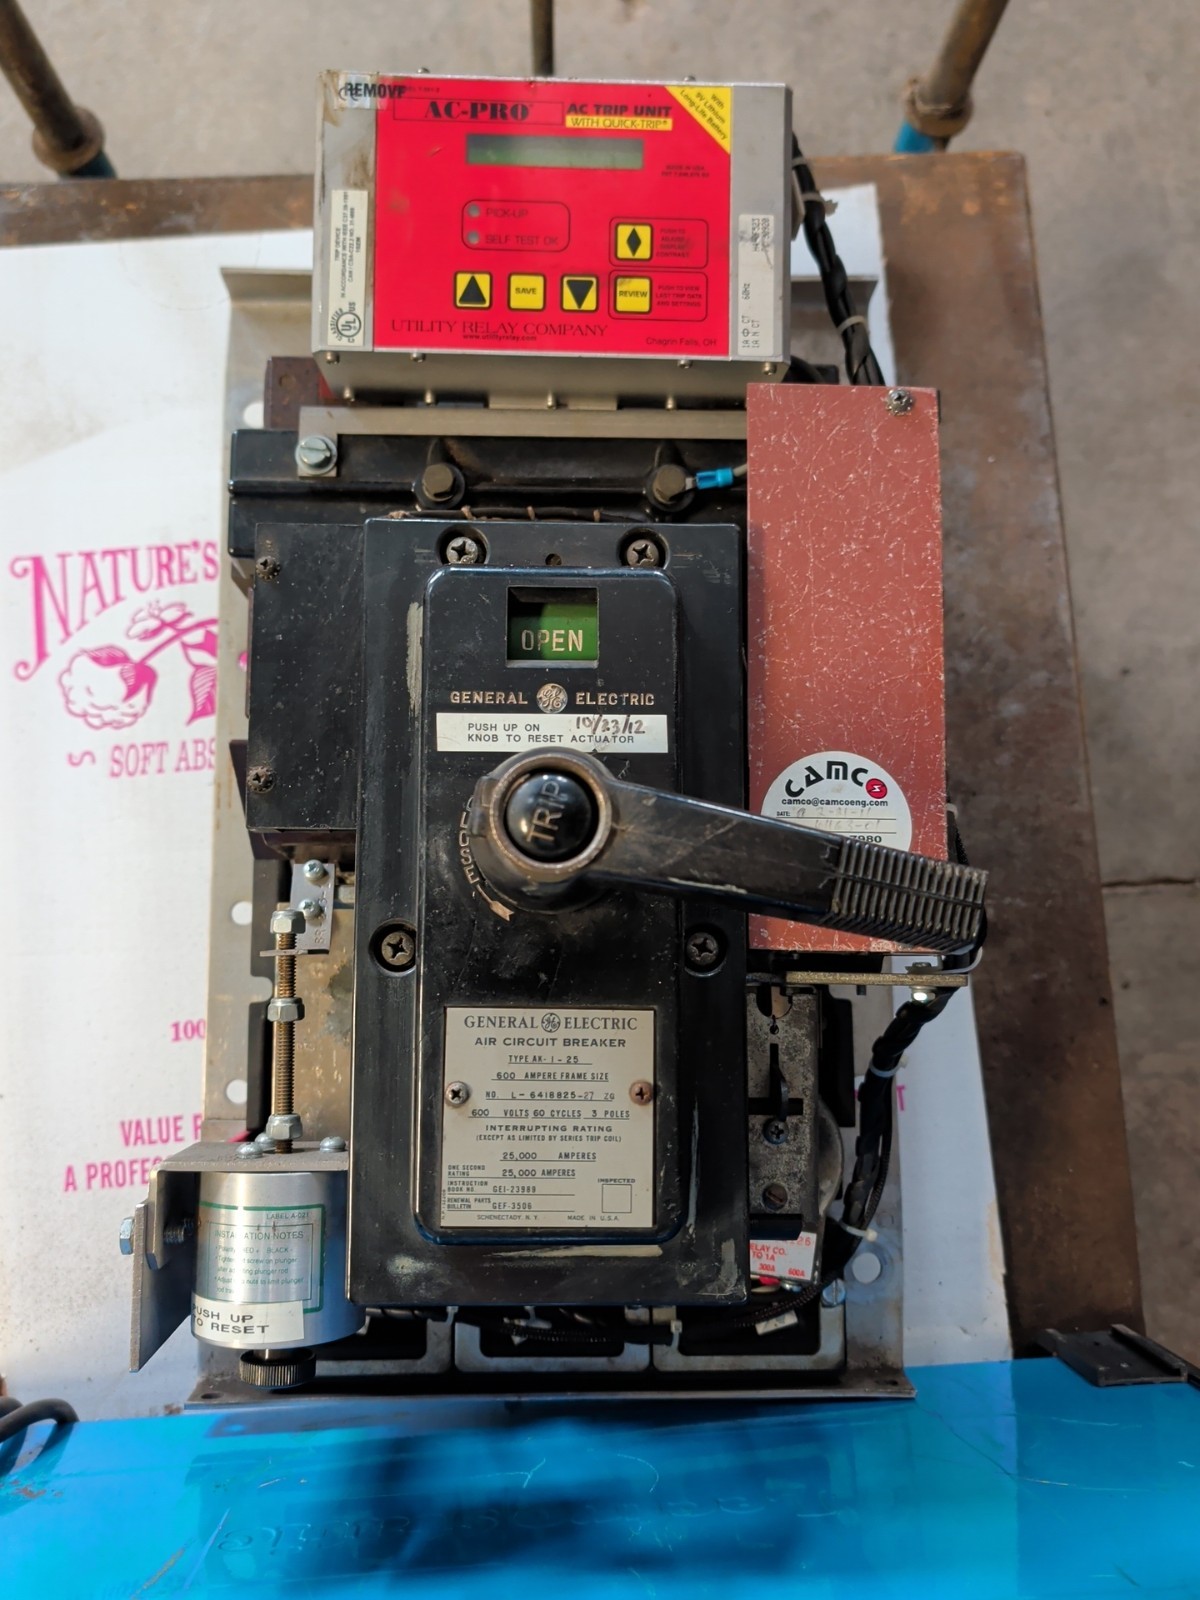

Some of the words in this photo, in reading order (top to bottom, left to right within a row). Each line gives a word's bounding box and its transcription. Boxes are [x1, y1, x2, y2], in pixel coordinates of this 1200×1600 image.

[710, 93, 725, 110] With
[425, 101, 530, 121] AC-PRO
[566, 103, 588, 115] AC
[593, 104, 628, 116] TRIP
[634, 105, 673, 117] UNIT
[680, 90, 707, 119] Long-Life
[706, 117, 728, 141] Battery
[571, 117, 600, 127] WITH
[486, 207, 529, 219] PICK-UP
[485, 233, 511, 245] SELF
[515, 235, 540, 245] TEST
[543, 236, 560, 246] OK
[514, 287, 537, 295] SAVE
[618, 289, 648, 298] REVIEW
[391, 319, 458, 334] UTILITY
[463, 321, 532, 335] RELAY
[536, 322, 608, 337] COMPANY
[462, 332, 538, 342] www.utilityrelay.com
[645, 337, 676, 347] Chagrin
[679, 338, 702, 348] Falls,
[703, 338, 718, 347] OH
[10, 540, 219, 681] NATURE'S
[521, 629, 583, 652] OPEN
[449, 690, 529, 705] GENERAL
[575, 692, 656, 706] ELECTRIC
[468, 723, 498, 732] PUSH
[503, 723, 518, 732] UP
[524, 723, 540, 732] ON
[575, 714, 647, 735] 10/23/12
[467, 734, 499, 743] KNOB
[506, 734, 522, 743] TO
[528, 734, 564, 743] RESET
[570, 735, 635, 744] ACTUATOR
[109, 742, 169, 778] SOFT
[781, 798, 889, 808] camco@camcoeng.com
[526, 780, 566, 843] TRIP
[463, 1015, 539, 1029] GENERAL
[564, 1016, 639, 1031] ELECTRIC
[474, 1037, 497, 1047] AIR
[502, 1037, 558, 1047] CIRCUIT
[563, 1038, 627, 1048] BREAKER
[508, 1054, 530, 1063] TYPE
[496, 1072, 516, 1080] 600
[524, 1072, 557, 1080] AMPERE
[560, 1072, 588, 1080] FRAME
[590, 1072, 609, 1081] SIZE
[471, 1109, 490, 1117] 600
[503, 1109, 530, 1117] VOLTS
[533, 1109, 546, 1118] 60
[550, 1110, 582, 1118] CYCLES
[591, 1110, 598, 1118] 3
[604, 1110, 631, 1119] POLES
[119, 1114, 185, 1147] VALUE
[572, 1125, 614, 1133] RATING
[476, 1134, 504, 1142] (EXCEPT
[506, 1134, 517, 1142] AS
[585, 1135, 602, 1143] TRIP
[604, 1135, 622, 1143] COIL)
[502, 1152, 538, 1161] 25,000
[557, 1152, 597, 1160] AMPERES
[64, 1165, 77, 1192] A
[501, 1169, 537, 1179] 25,000
[541, 1169, 576, 1177] AMPERES
[492, 1185, 537, 1193] GEI-23989
[491, 1202, 533, 1210] GEF-3506
[266, 1211, 289, 1220] LABEL
[214, 1230, 271, 1240] INSTAATION
[272, 1231, 304, 1240] NOTES
[772, 1247, 787, 1256] CO.
[274, 1257, 297, 1265] plunger
[230, 1314, 254, 1323] UP
[211, 1322, 270, 1334] RESET
